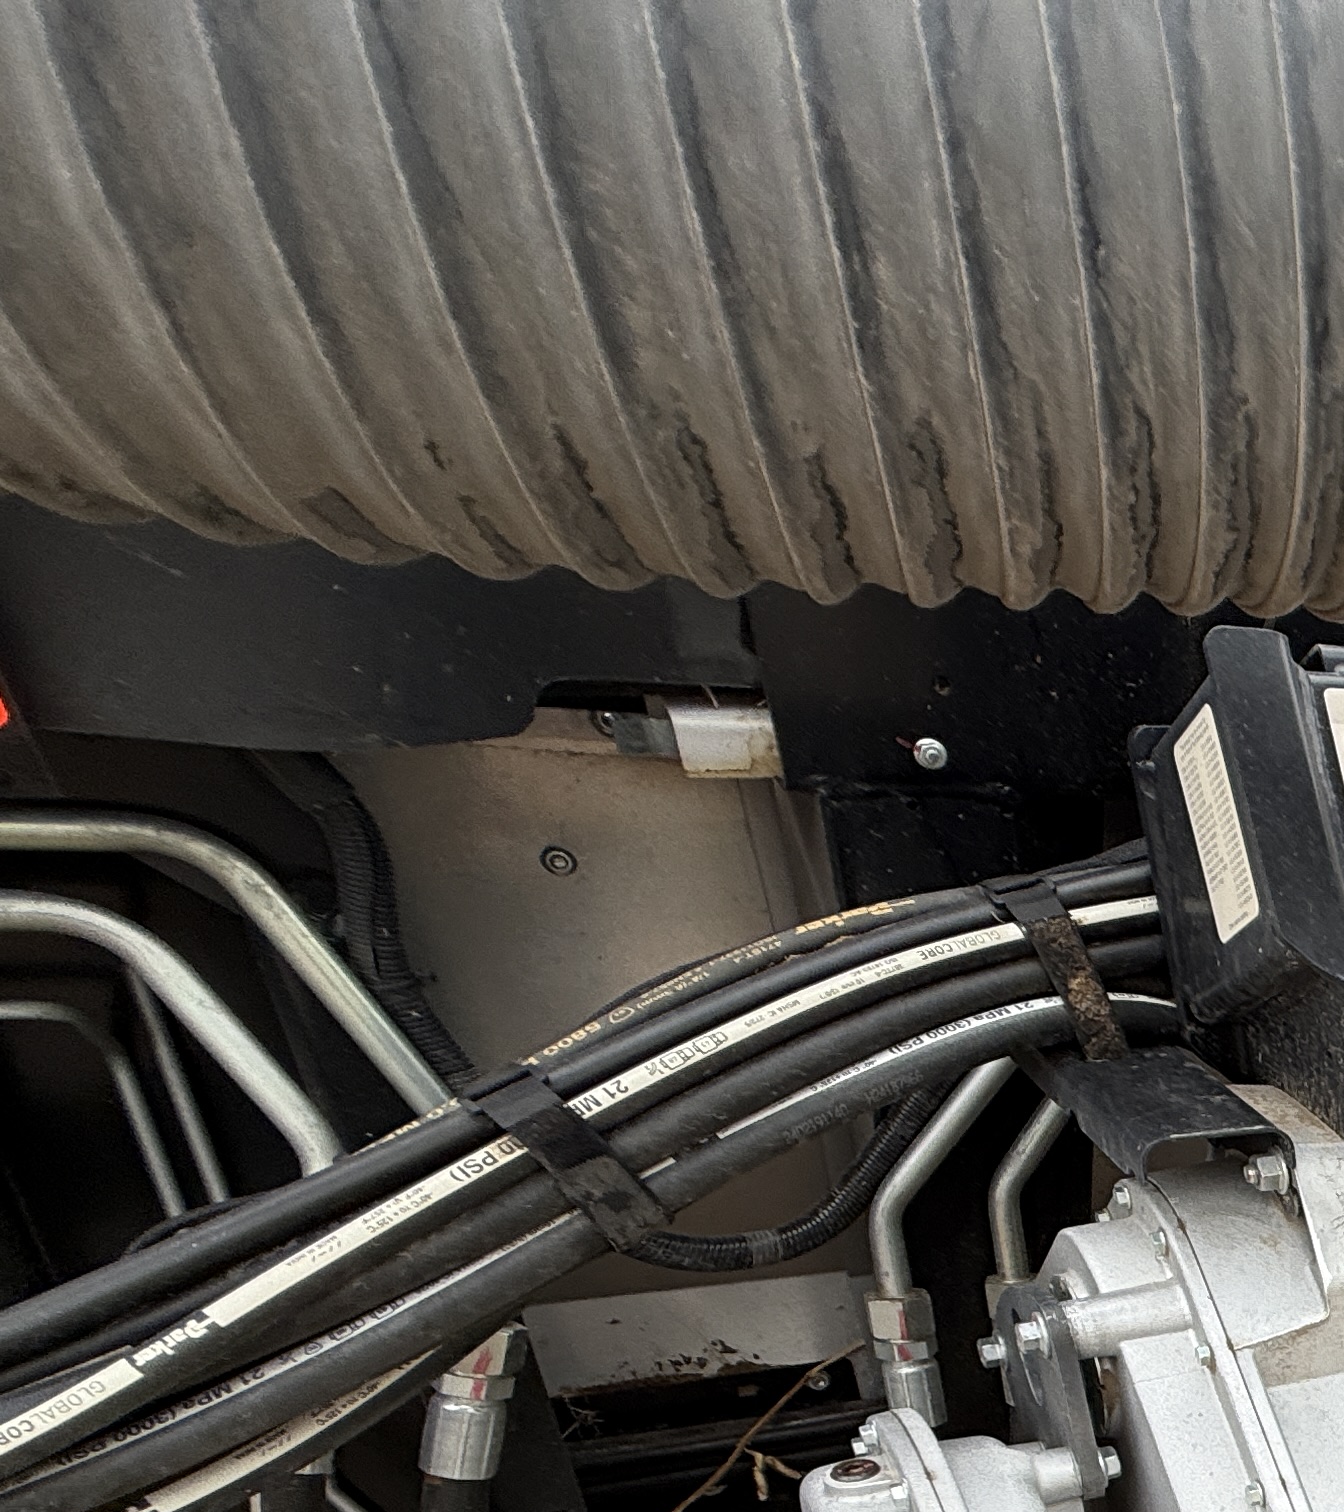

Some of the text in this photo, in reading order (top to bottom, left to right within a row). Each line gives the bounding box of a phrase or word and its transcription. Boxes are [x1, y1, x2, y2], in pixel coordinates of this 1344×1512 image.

[916, 926, 1001, 966] GLOBALCORE
[601, 1076, 630, 1101] 21
[447, 1148, 498, 1186] PSI)
[134, 1319, 209, 1367] Parker
[237, 1366, 266, 1387] 21
